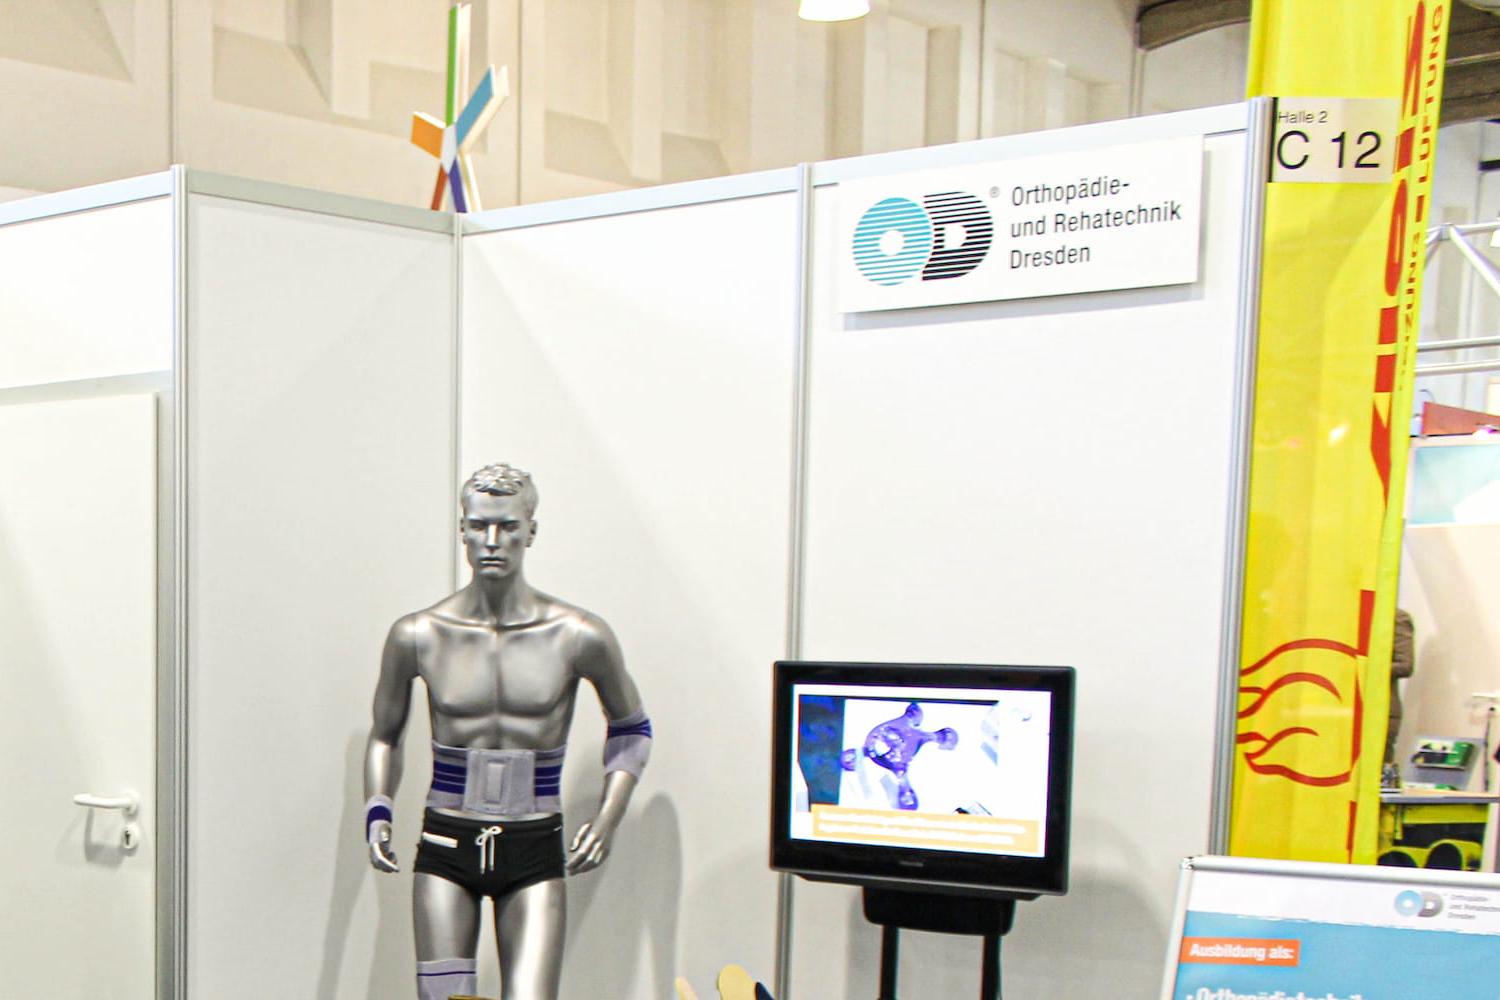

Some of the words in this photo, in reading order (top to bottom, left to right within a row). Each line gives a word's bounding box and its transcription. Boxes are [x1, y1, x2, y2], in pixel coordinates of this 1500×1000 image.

[1278, 110, 1314, 124] Halle
[1317, 111, 1328, 124] 2
[1276, 130, 1309, 170] C
[1330, 131, 1381, 169] 12
[1011, 173, 1130, 206] Orthopädie-
[1010, 213, 1047, 238] und
[1054, 200, 1182, 235] Rehatechnik
[1010, 243, 1091, 270] Dresden
[1190, 944, 1266, 961] Ausbildung
[1268, 946, 1294, 960] als:
